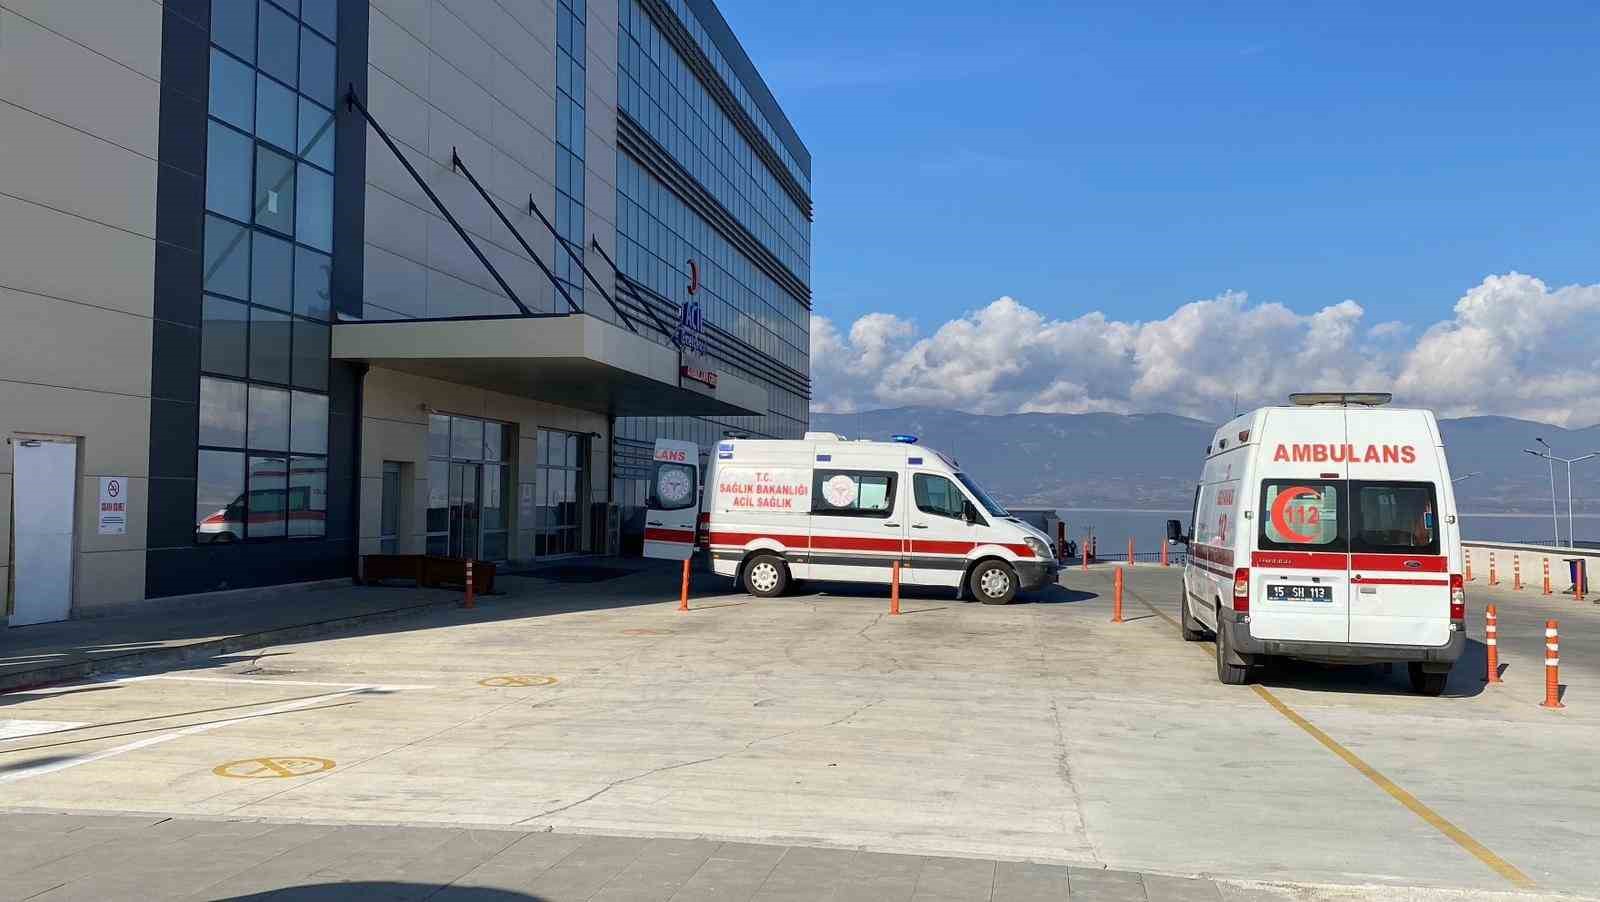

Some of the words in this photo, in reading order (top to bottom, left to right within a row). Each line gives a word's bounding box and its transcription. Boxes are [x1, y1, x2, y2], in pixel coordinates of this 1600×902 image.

[1273, 443, 1416, 464] AMBULANS
[719, 482, 753, 494] SAĞLIK
[756, 483, 808, 496] BAKANLIĞI
[757, 496, 792, 508] SAĞLIK
[1285, 506, 1320, 525] 112
